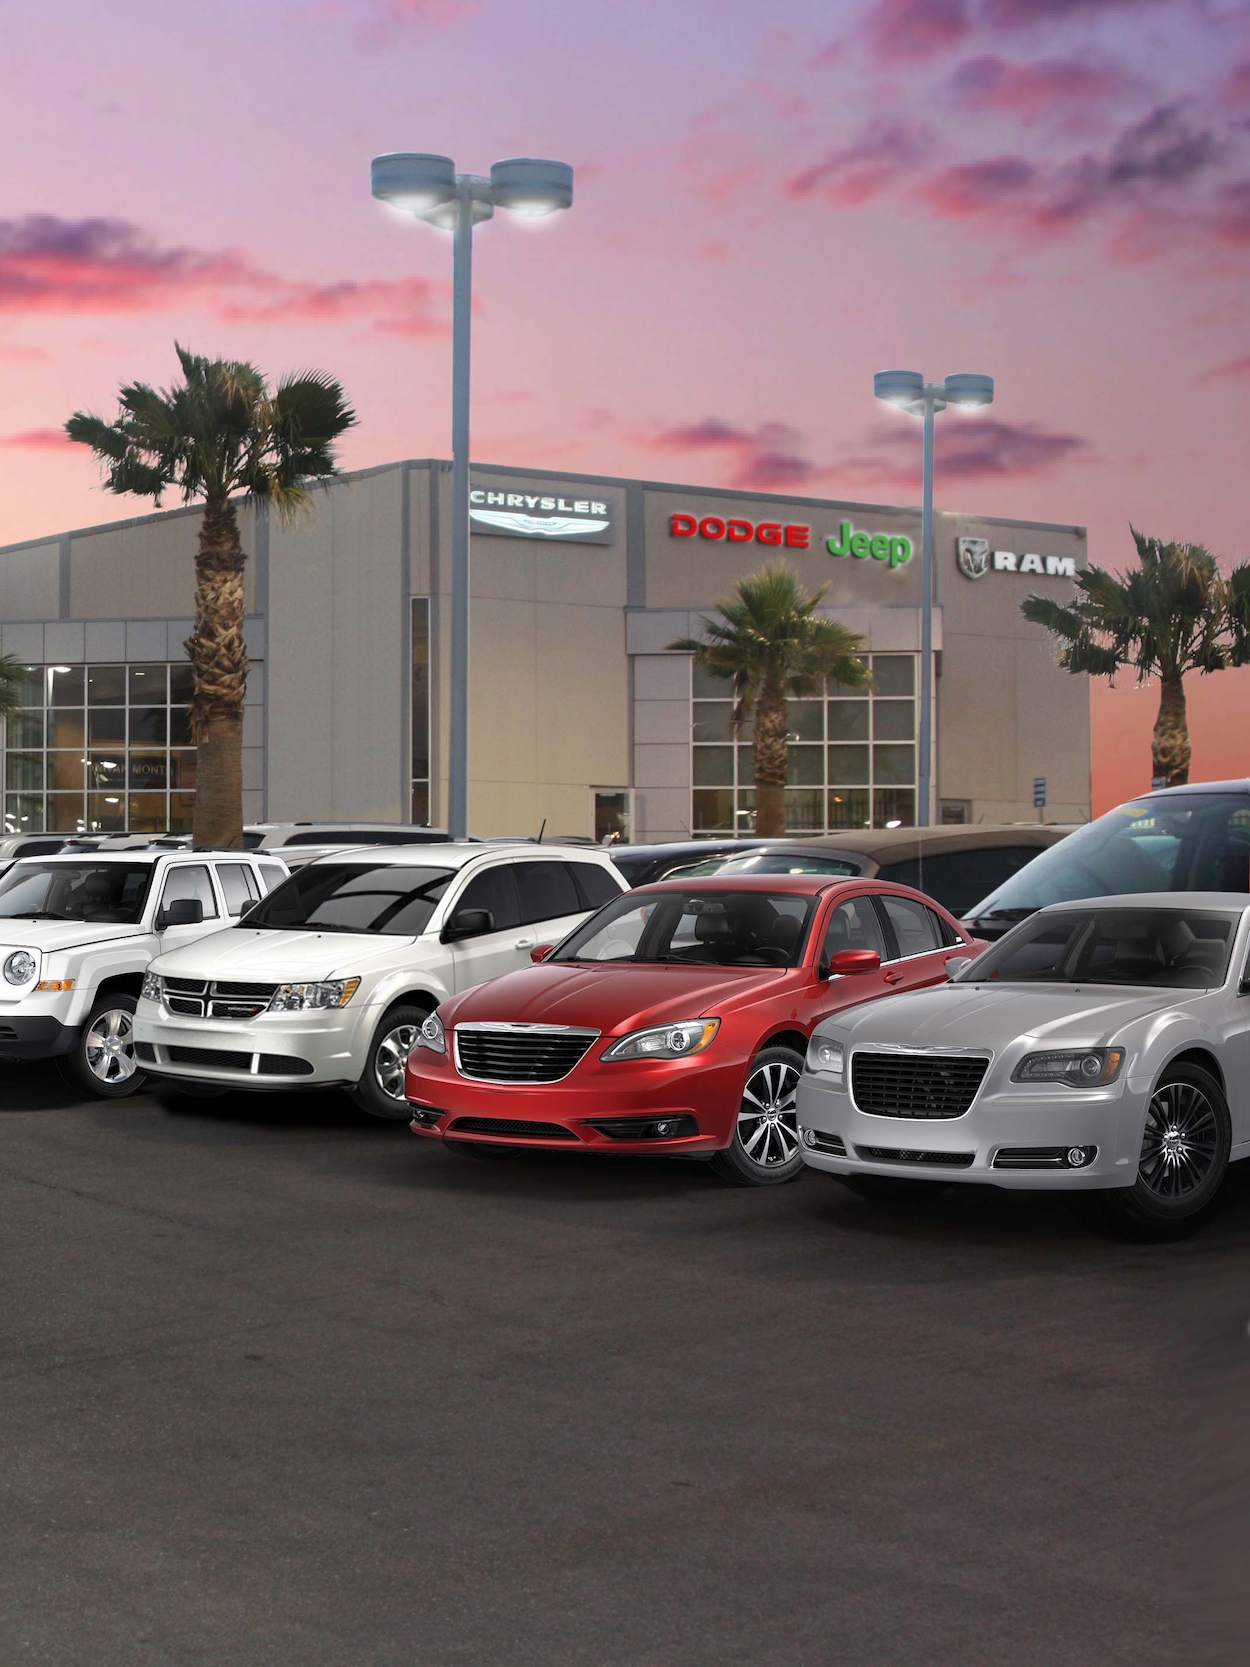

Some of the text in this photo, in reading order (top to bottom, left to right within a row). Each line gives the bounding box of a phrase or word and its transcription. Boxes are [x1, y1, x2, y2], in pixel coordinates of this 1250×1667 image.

[470, 490, 607, 515] CHRYSLER
[671, 513, 1075, 577] DODGE Jeep RAM
